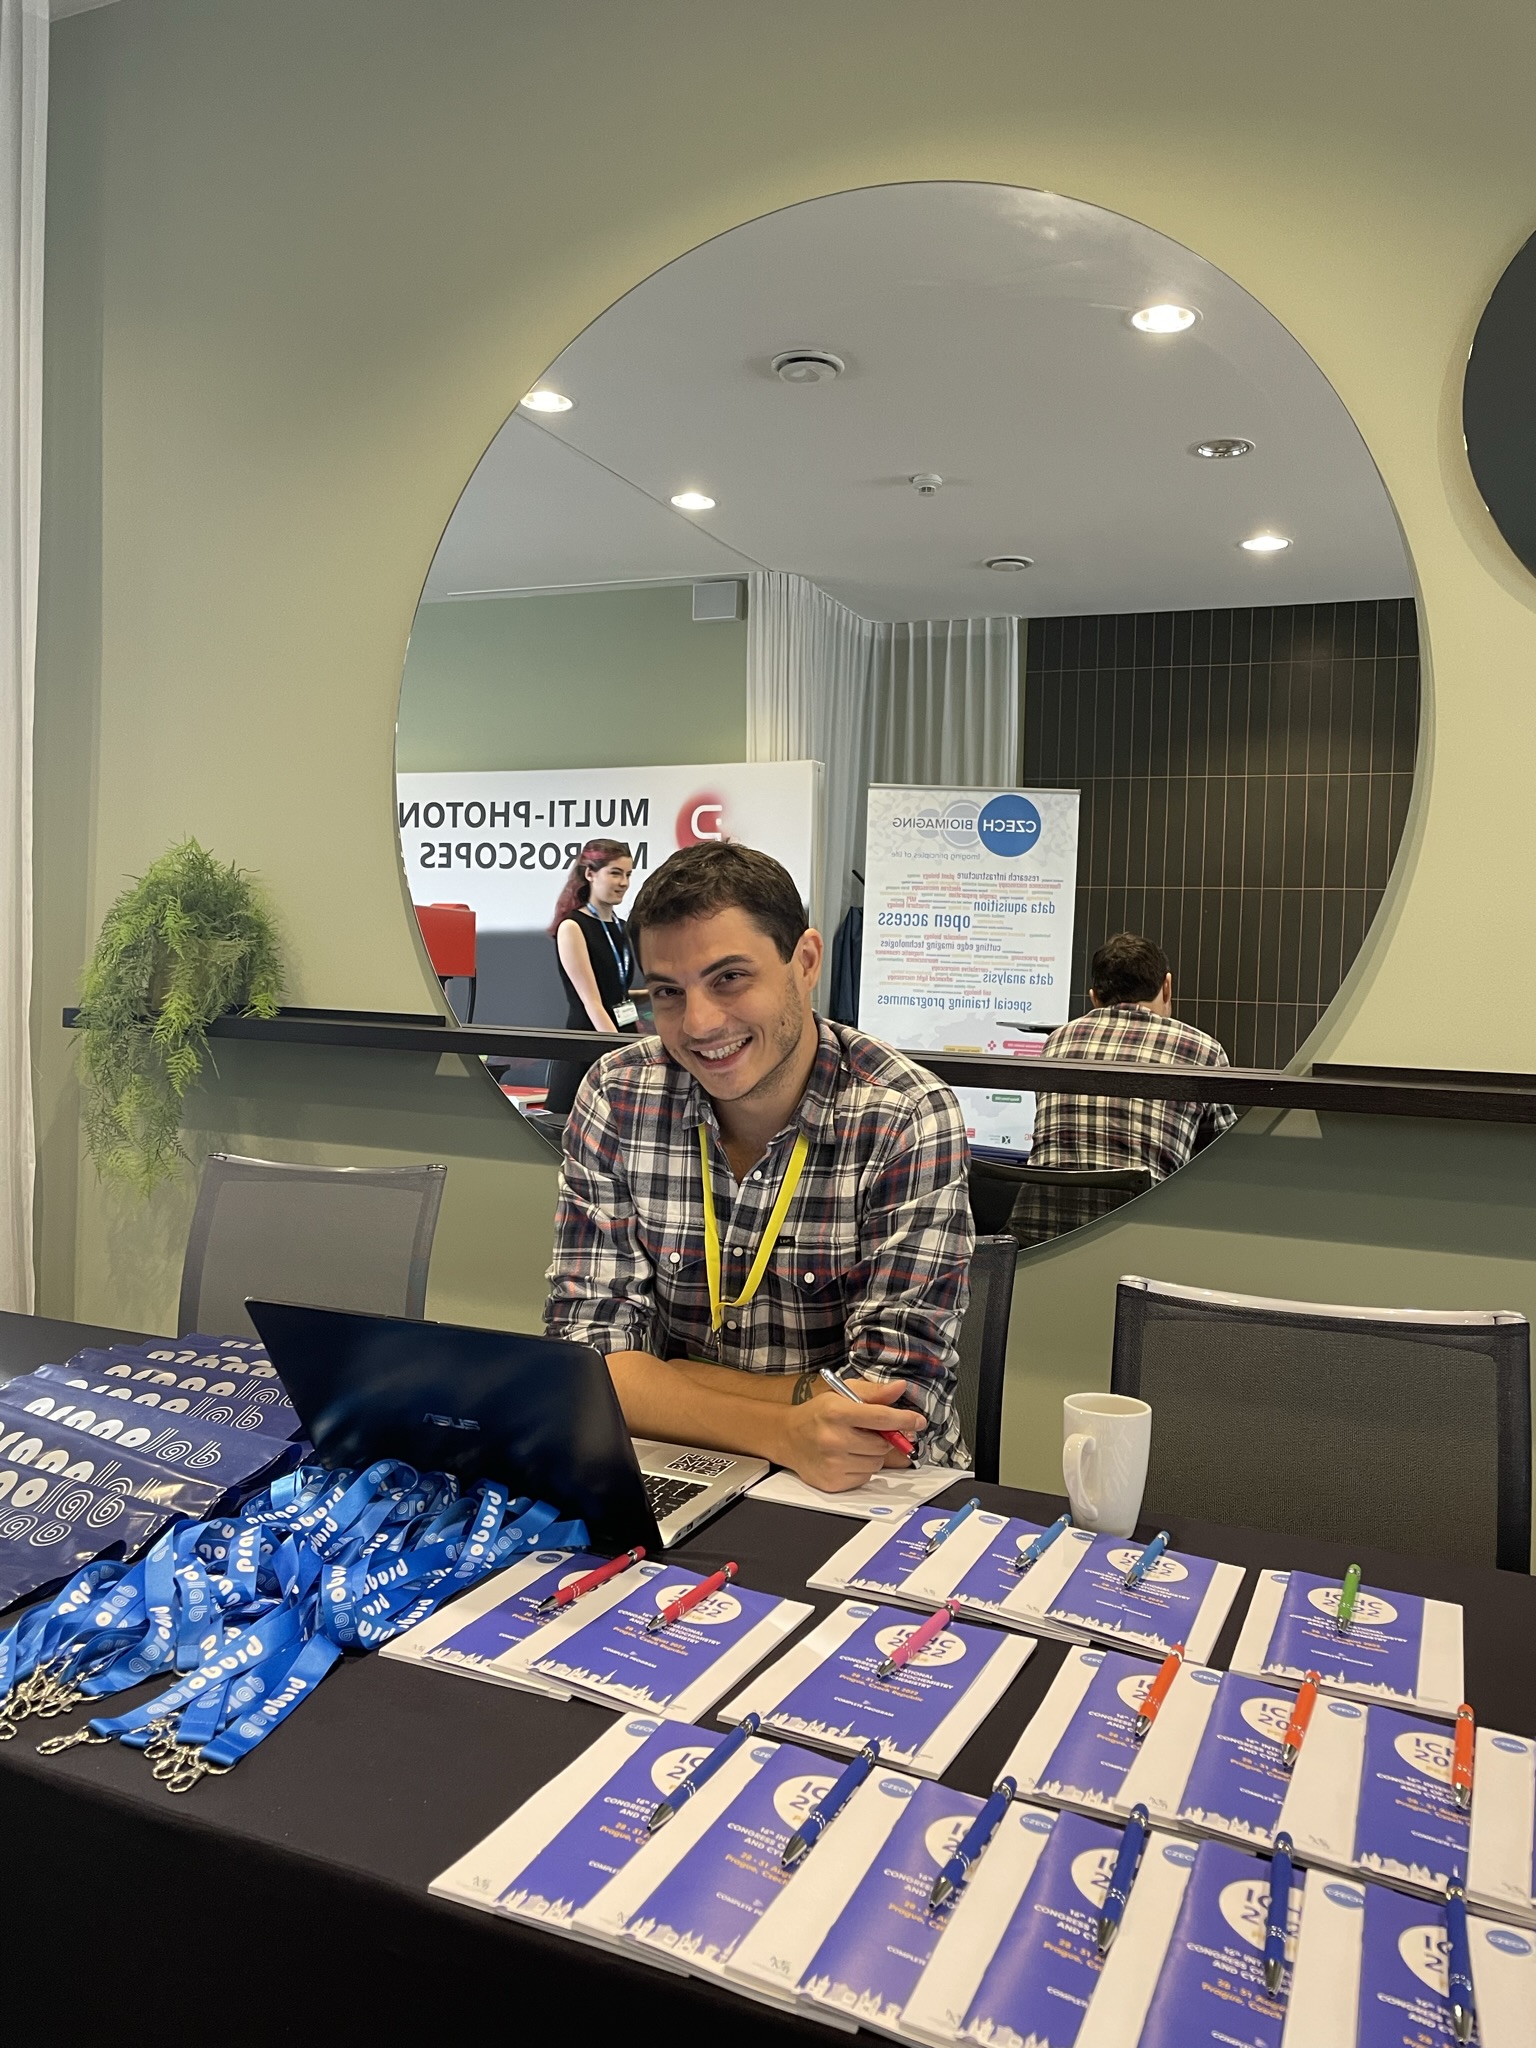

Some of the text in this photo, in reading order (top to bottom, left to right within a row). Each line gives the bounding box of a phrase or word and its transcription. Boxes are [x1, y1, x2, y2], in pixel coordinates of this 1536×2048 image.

[422, 1412, 480, 1431] ASUS
[744, 1837, 765, 1851] AND
[904, 1884, 927, 1898] AND
[1056, 1921, 1081, 1936] AND
